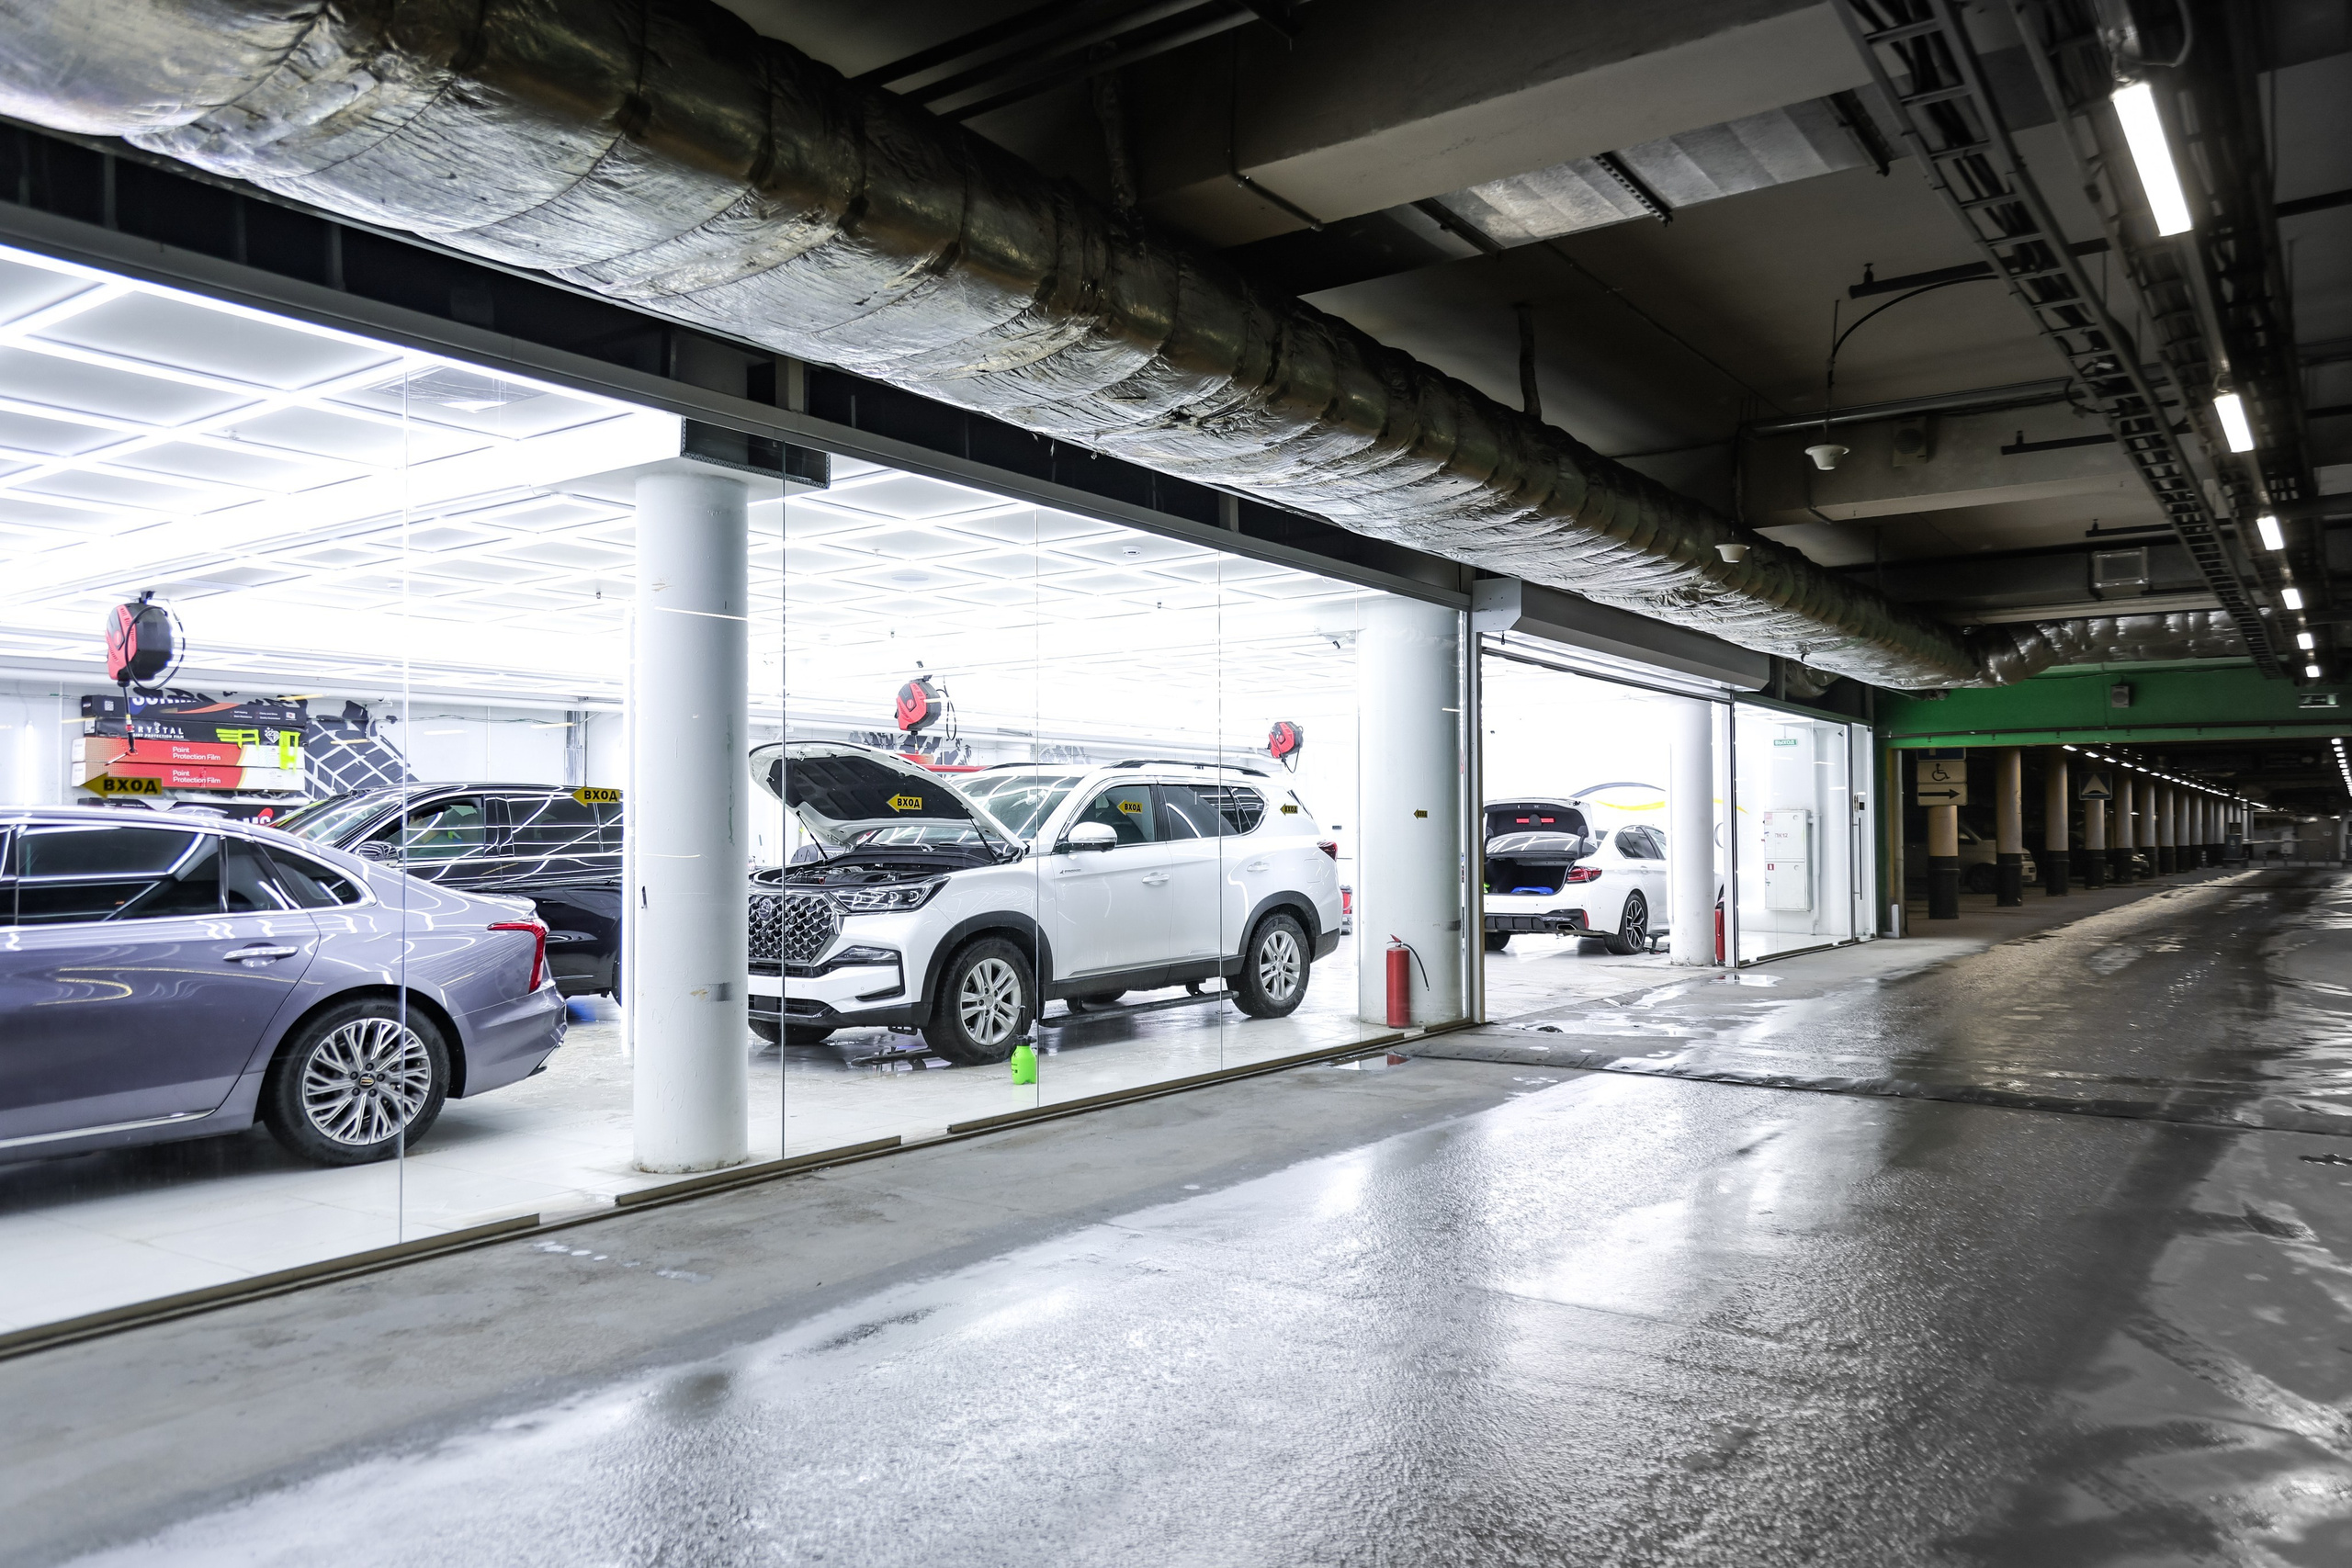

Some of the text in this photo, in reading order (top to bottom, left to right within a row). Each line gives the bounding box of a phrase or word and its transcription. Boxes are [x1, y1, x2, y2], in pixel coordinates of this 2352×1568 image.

[103, 779, 158, 794] ВХОД
[584, 790, 617, 802] ВХОД
[897, 797, 921, 808] ВХОД
[1124, 803, 1142, 813] ВХОД
